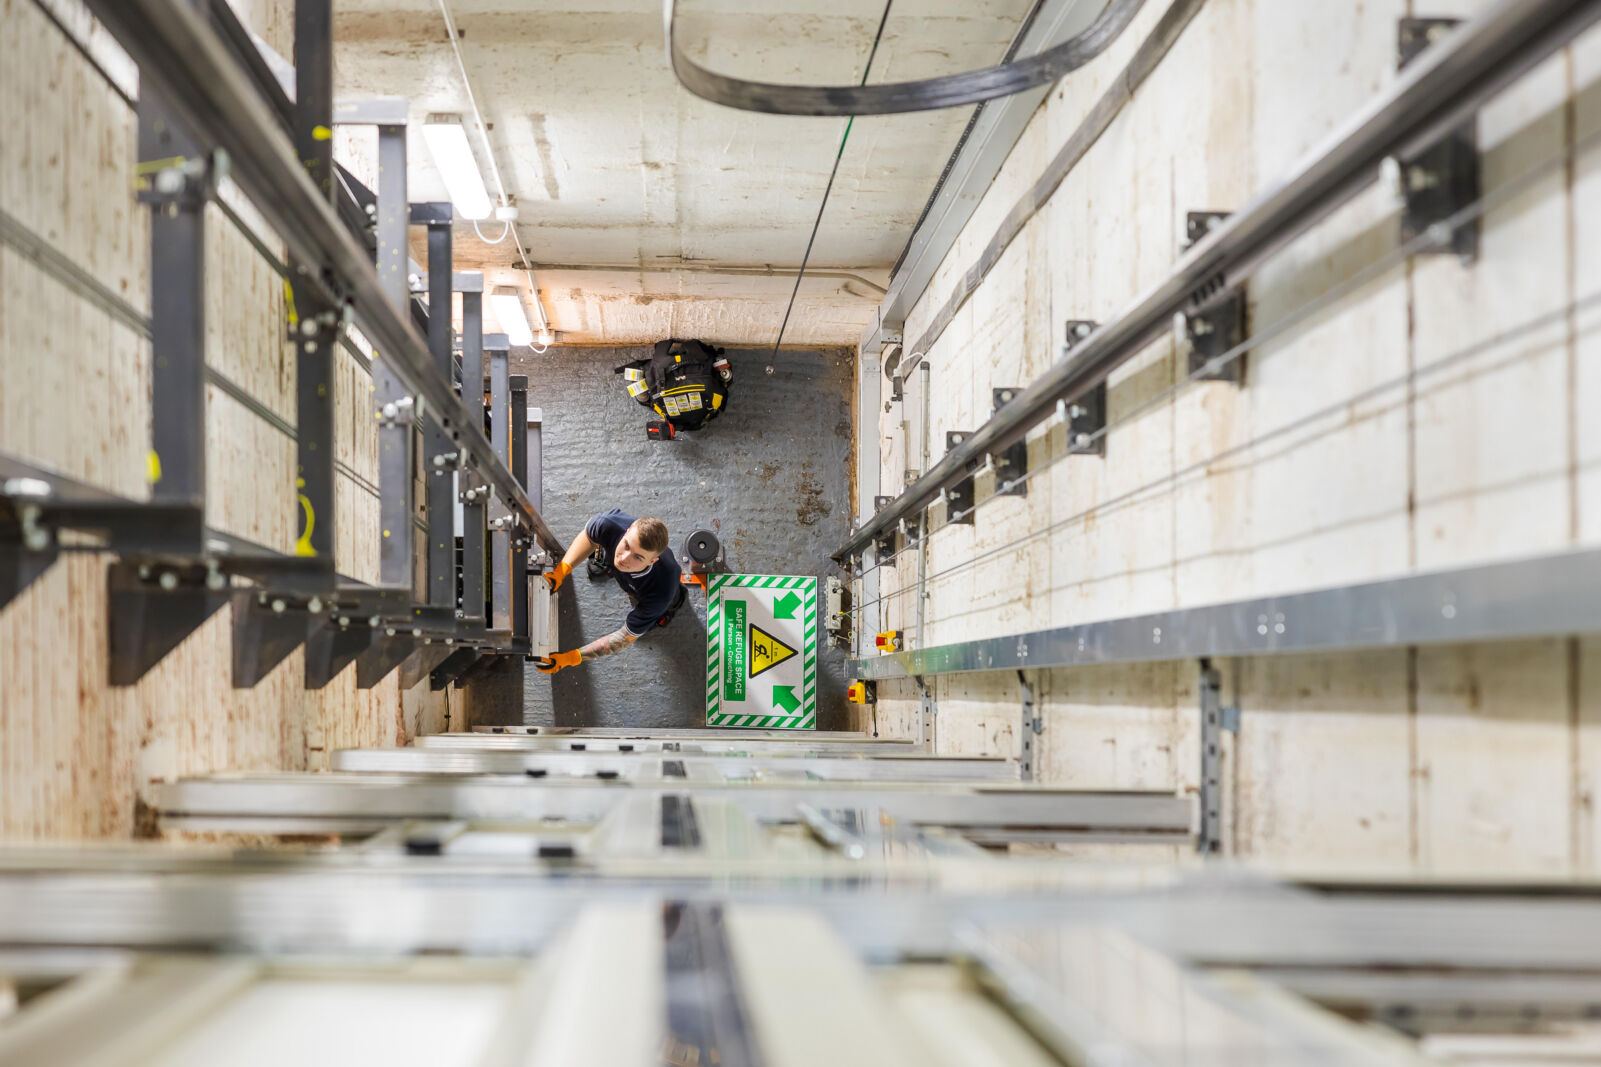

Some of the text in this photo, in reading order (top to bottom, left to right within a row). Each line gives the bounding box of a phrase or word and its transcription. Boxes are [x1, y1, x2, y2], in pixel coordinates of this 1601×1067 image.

[735, 607, 743, 694] SAFE REFUGE SPACE
